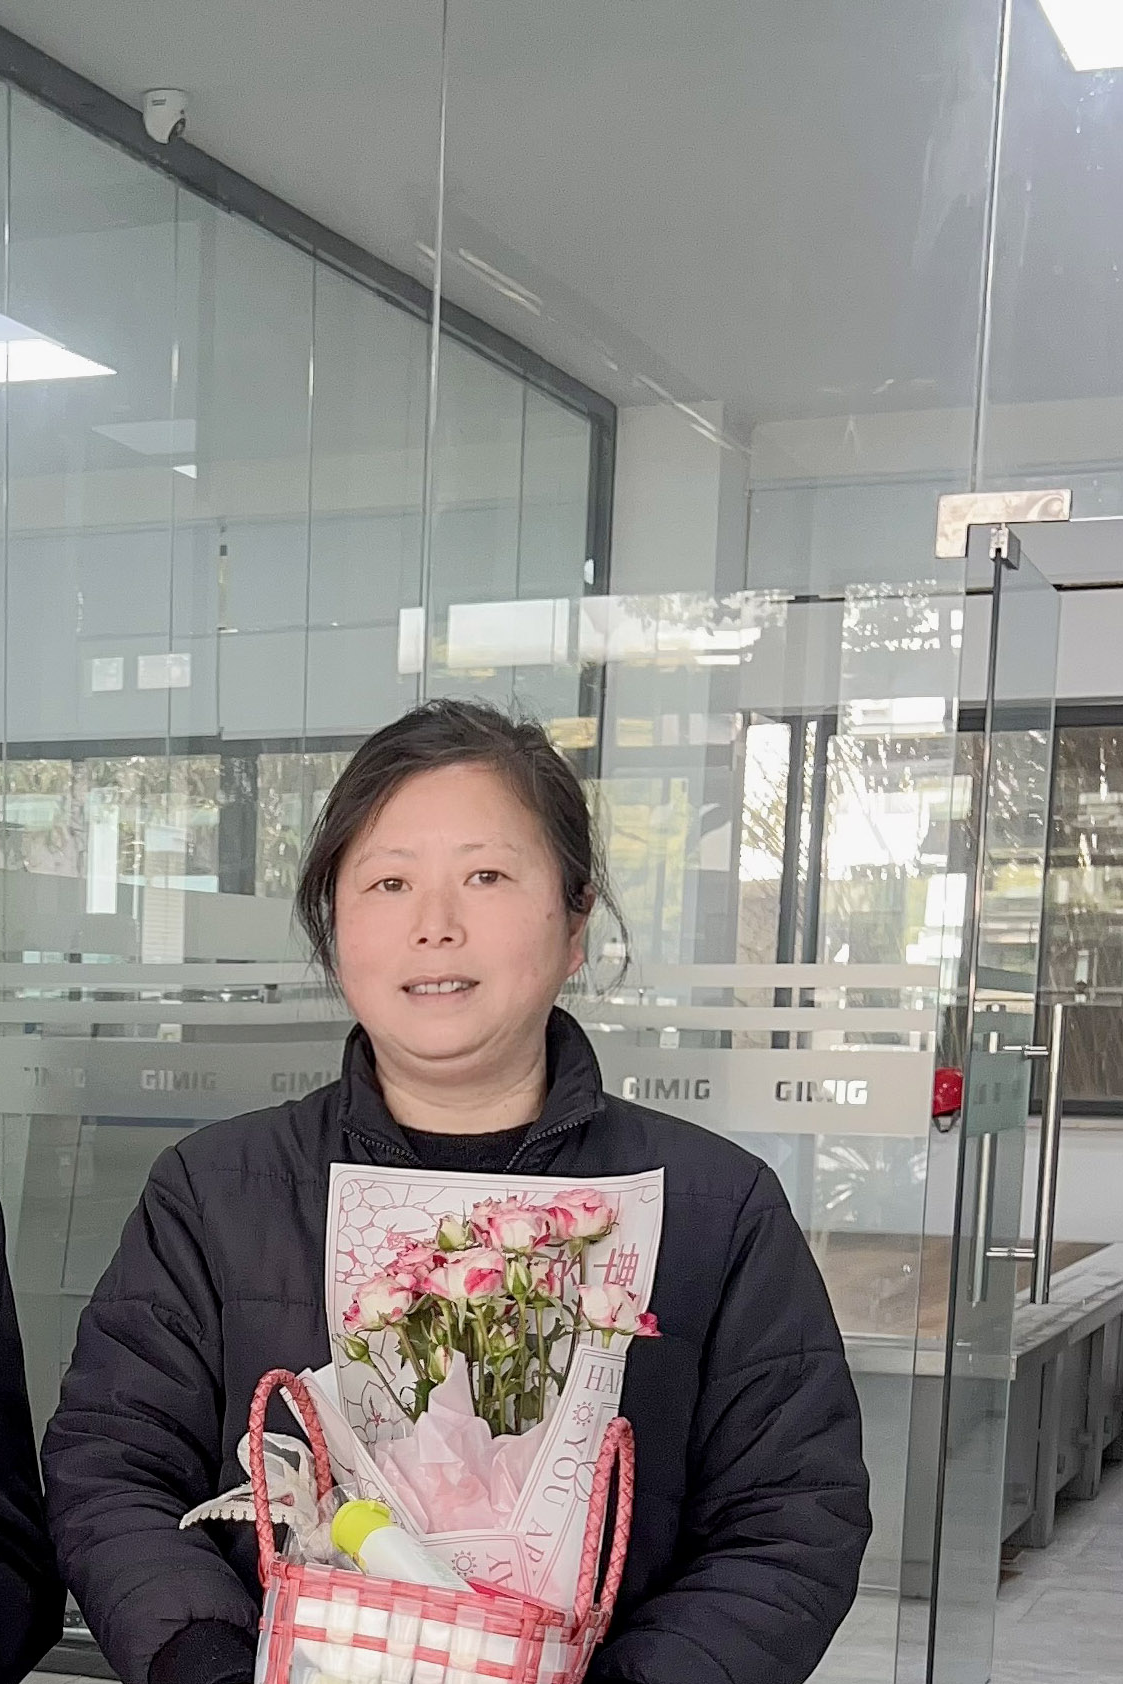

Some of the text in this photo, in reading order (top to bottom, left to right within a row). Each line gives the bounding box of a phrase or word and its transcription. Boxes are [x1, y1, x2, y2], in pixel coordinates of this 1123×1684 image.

[141, 1069, 218, 1091] GIMIG
[622, 1077, 710, 1101] GIMIG
[775, 1080, 868, 1105] GIMIG
[543, 1434, 588, 1508] YOU
